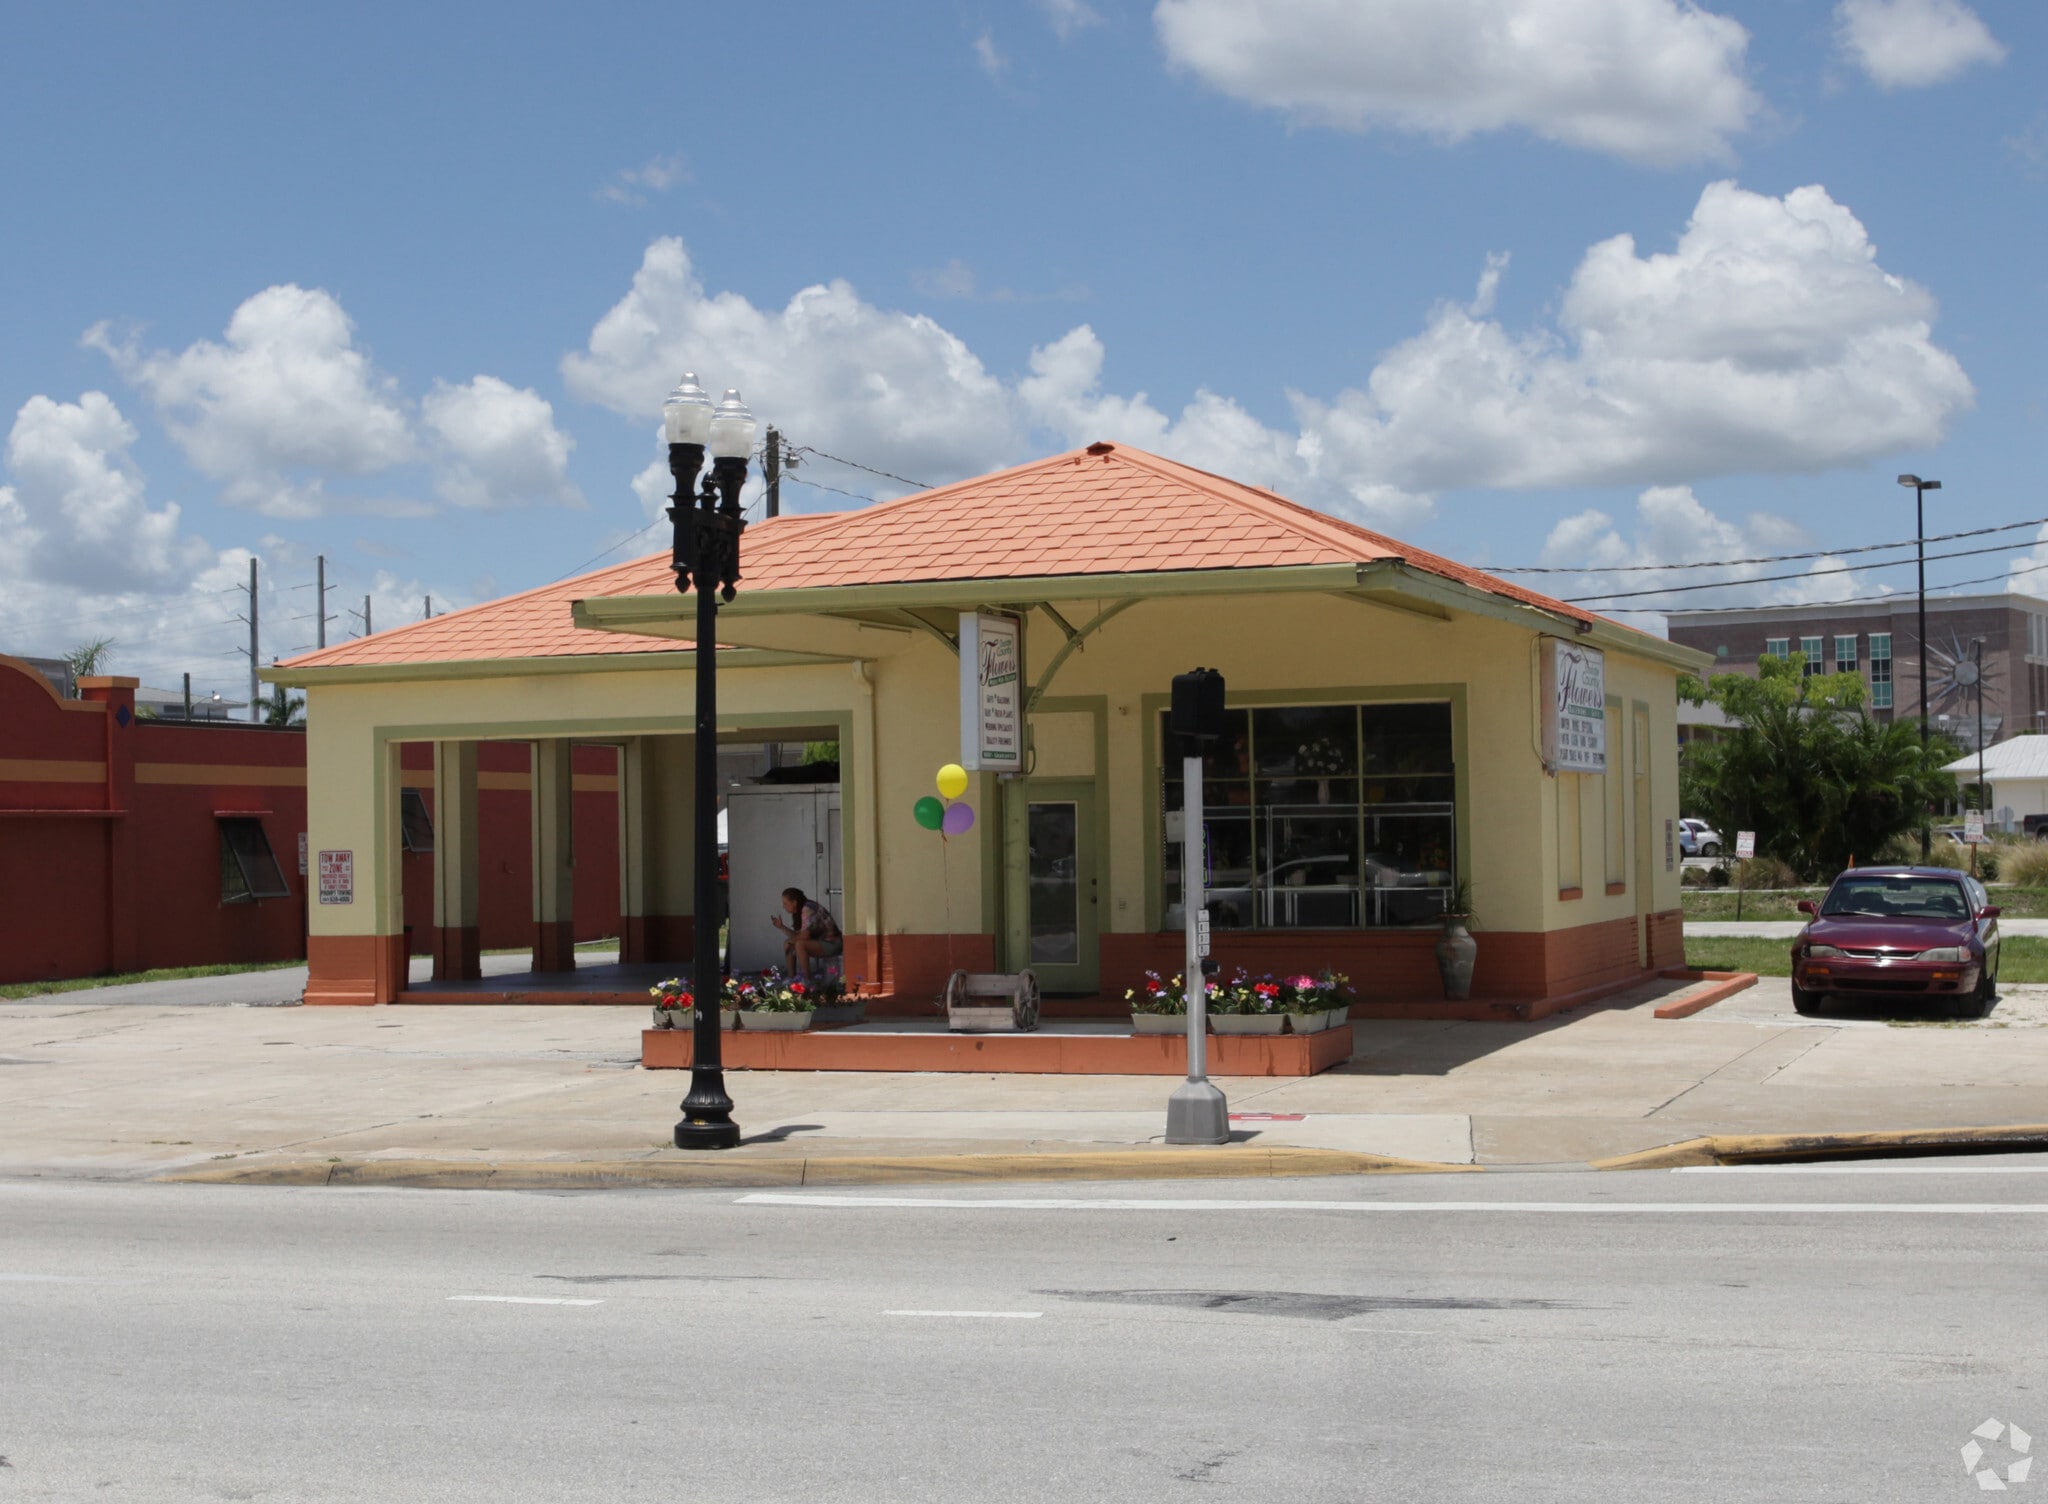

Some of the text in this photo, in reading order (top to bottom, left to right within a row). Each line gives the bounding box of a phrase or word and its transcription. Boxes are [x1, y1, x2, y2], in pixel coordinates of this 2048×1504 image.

[979, 638, 1016, 686] Flowers
[1558, 652, 1602, 712] Flowers
[321, 853, 350, 864] TOW AWAY
[329, 863, 343, 874] ZONE
